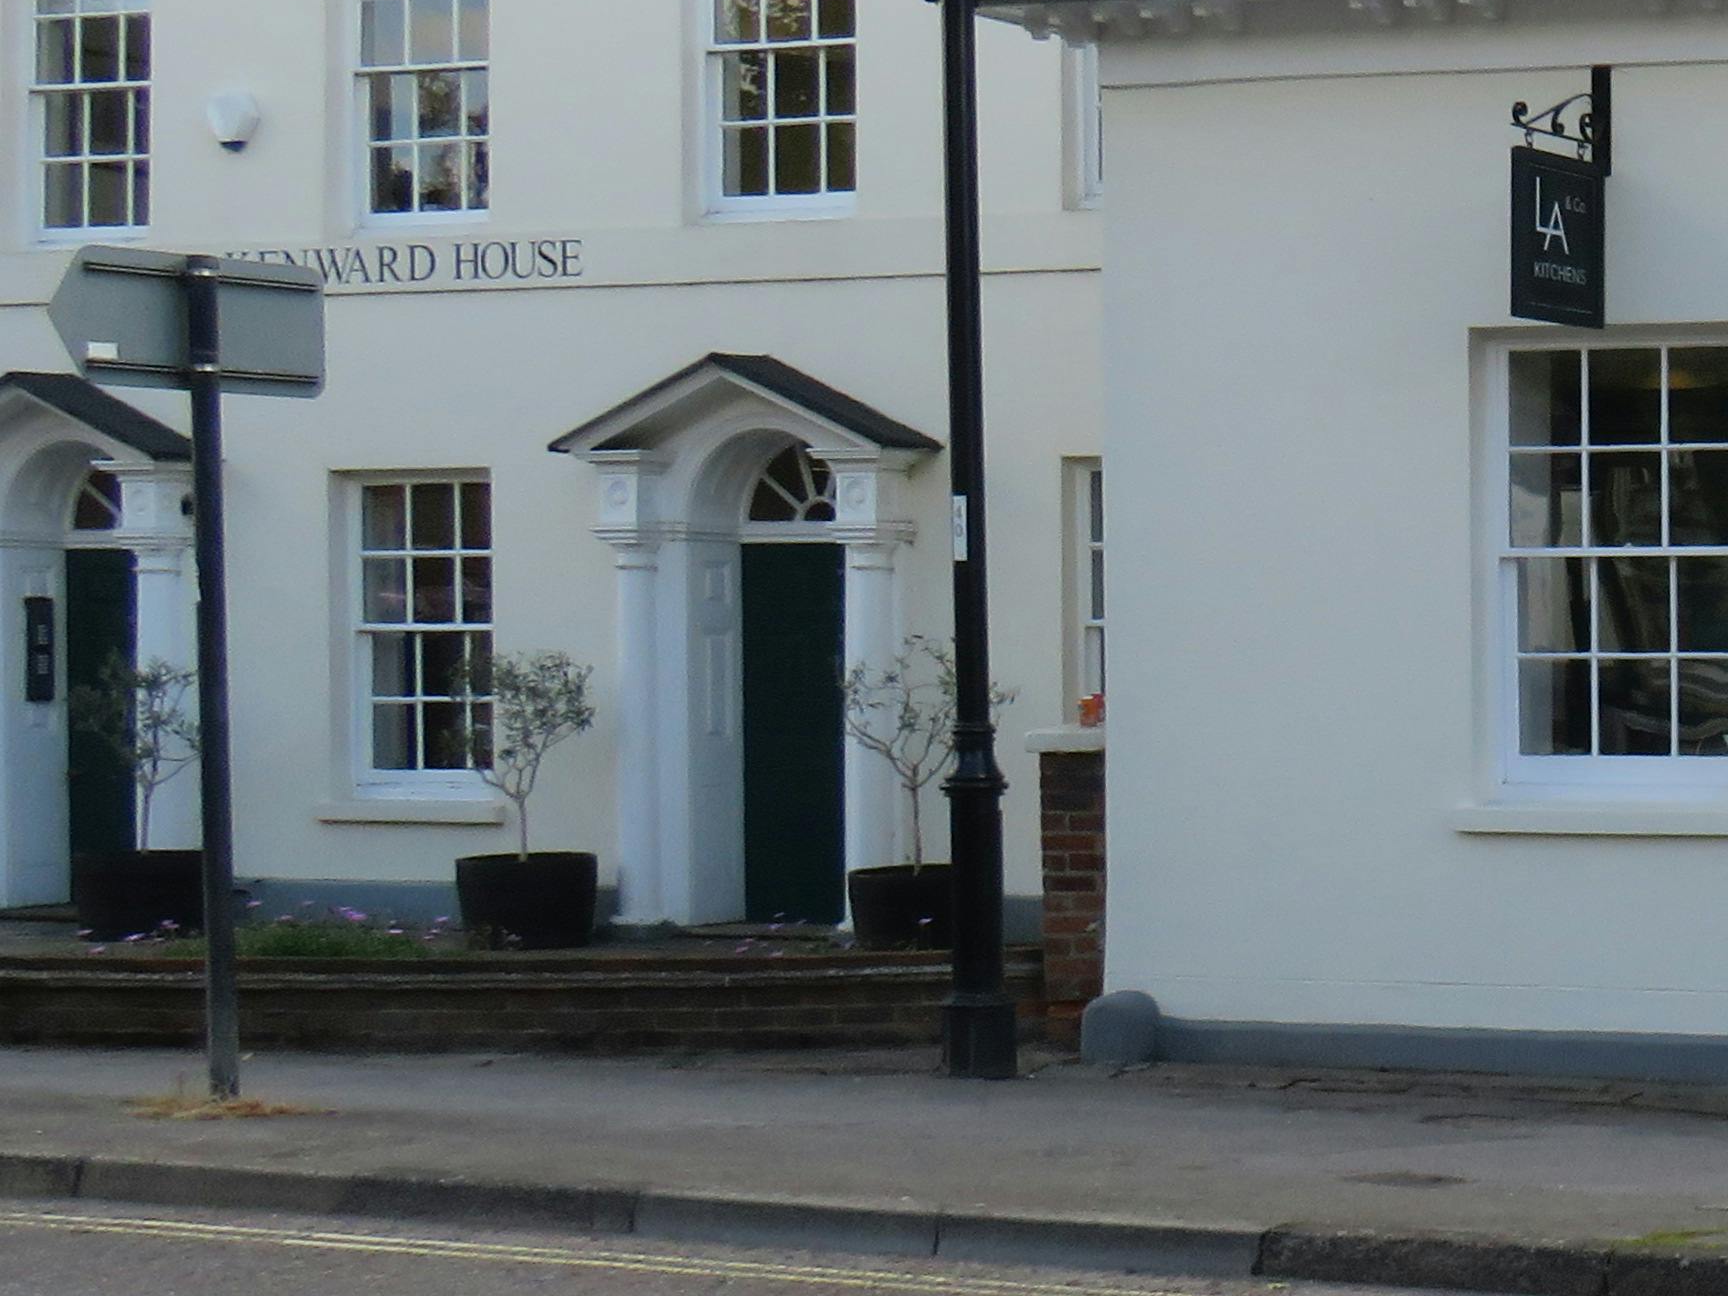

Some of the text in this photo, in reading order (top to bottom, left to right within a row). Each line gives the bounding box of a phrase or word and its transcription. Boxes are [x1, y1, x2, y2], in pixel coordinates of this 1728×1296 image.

[225, 239, 583, 285] WARD HOUSE
[1533, 261, 1587, 286] KITCHENS
